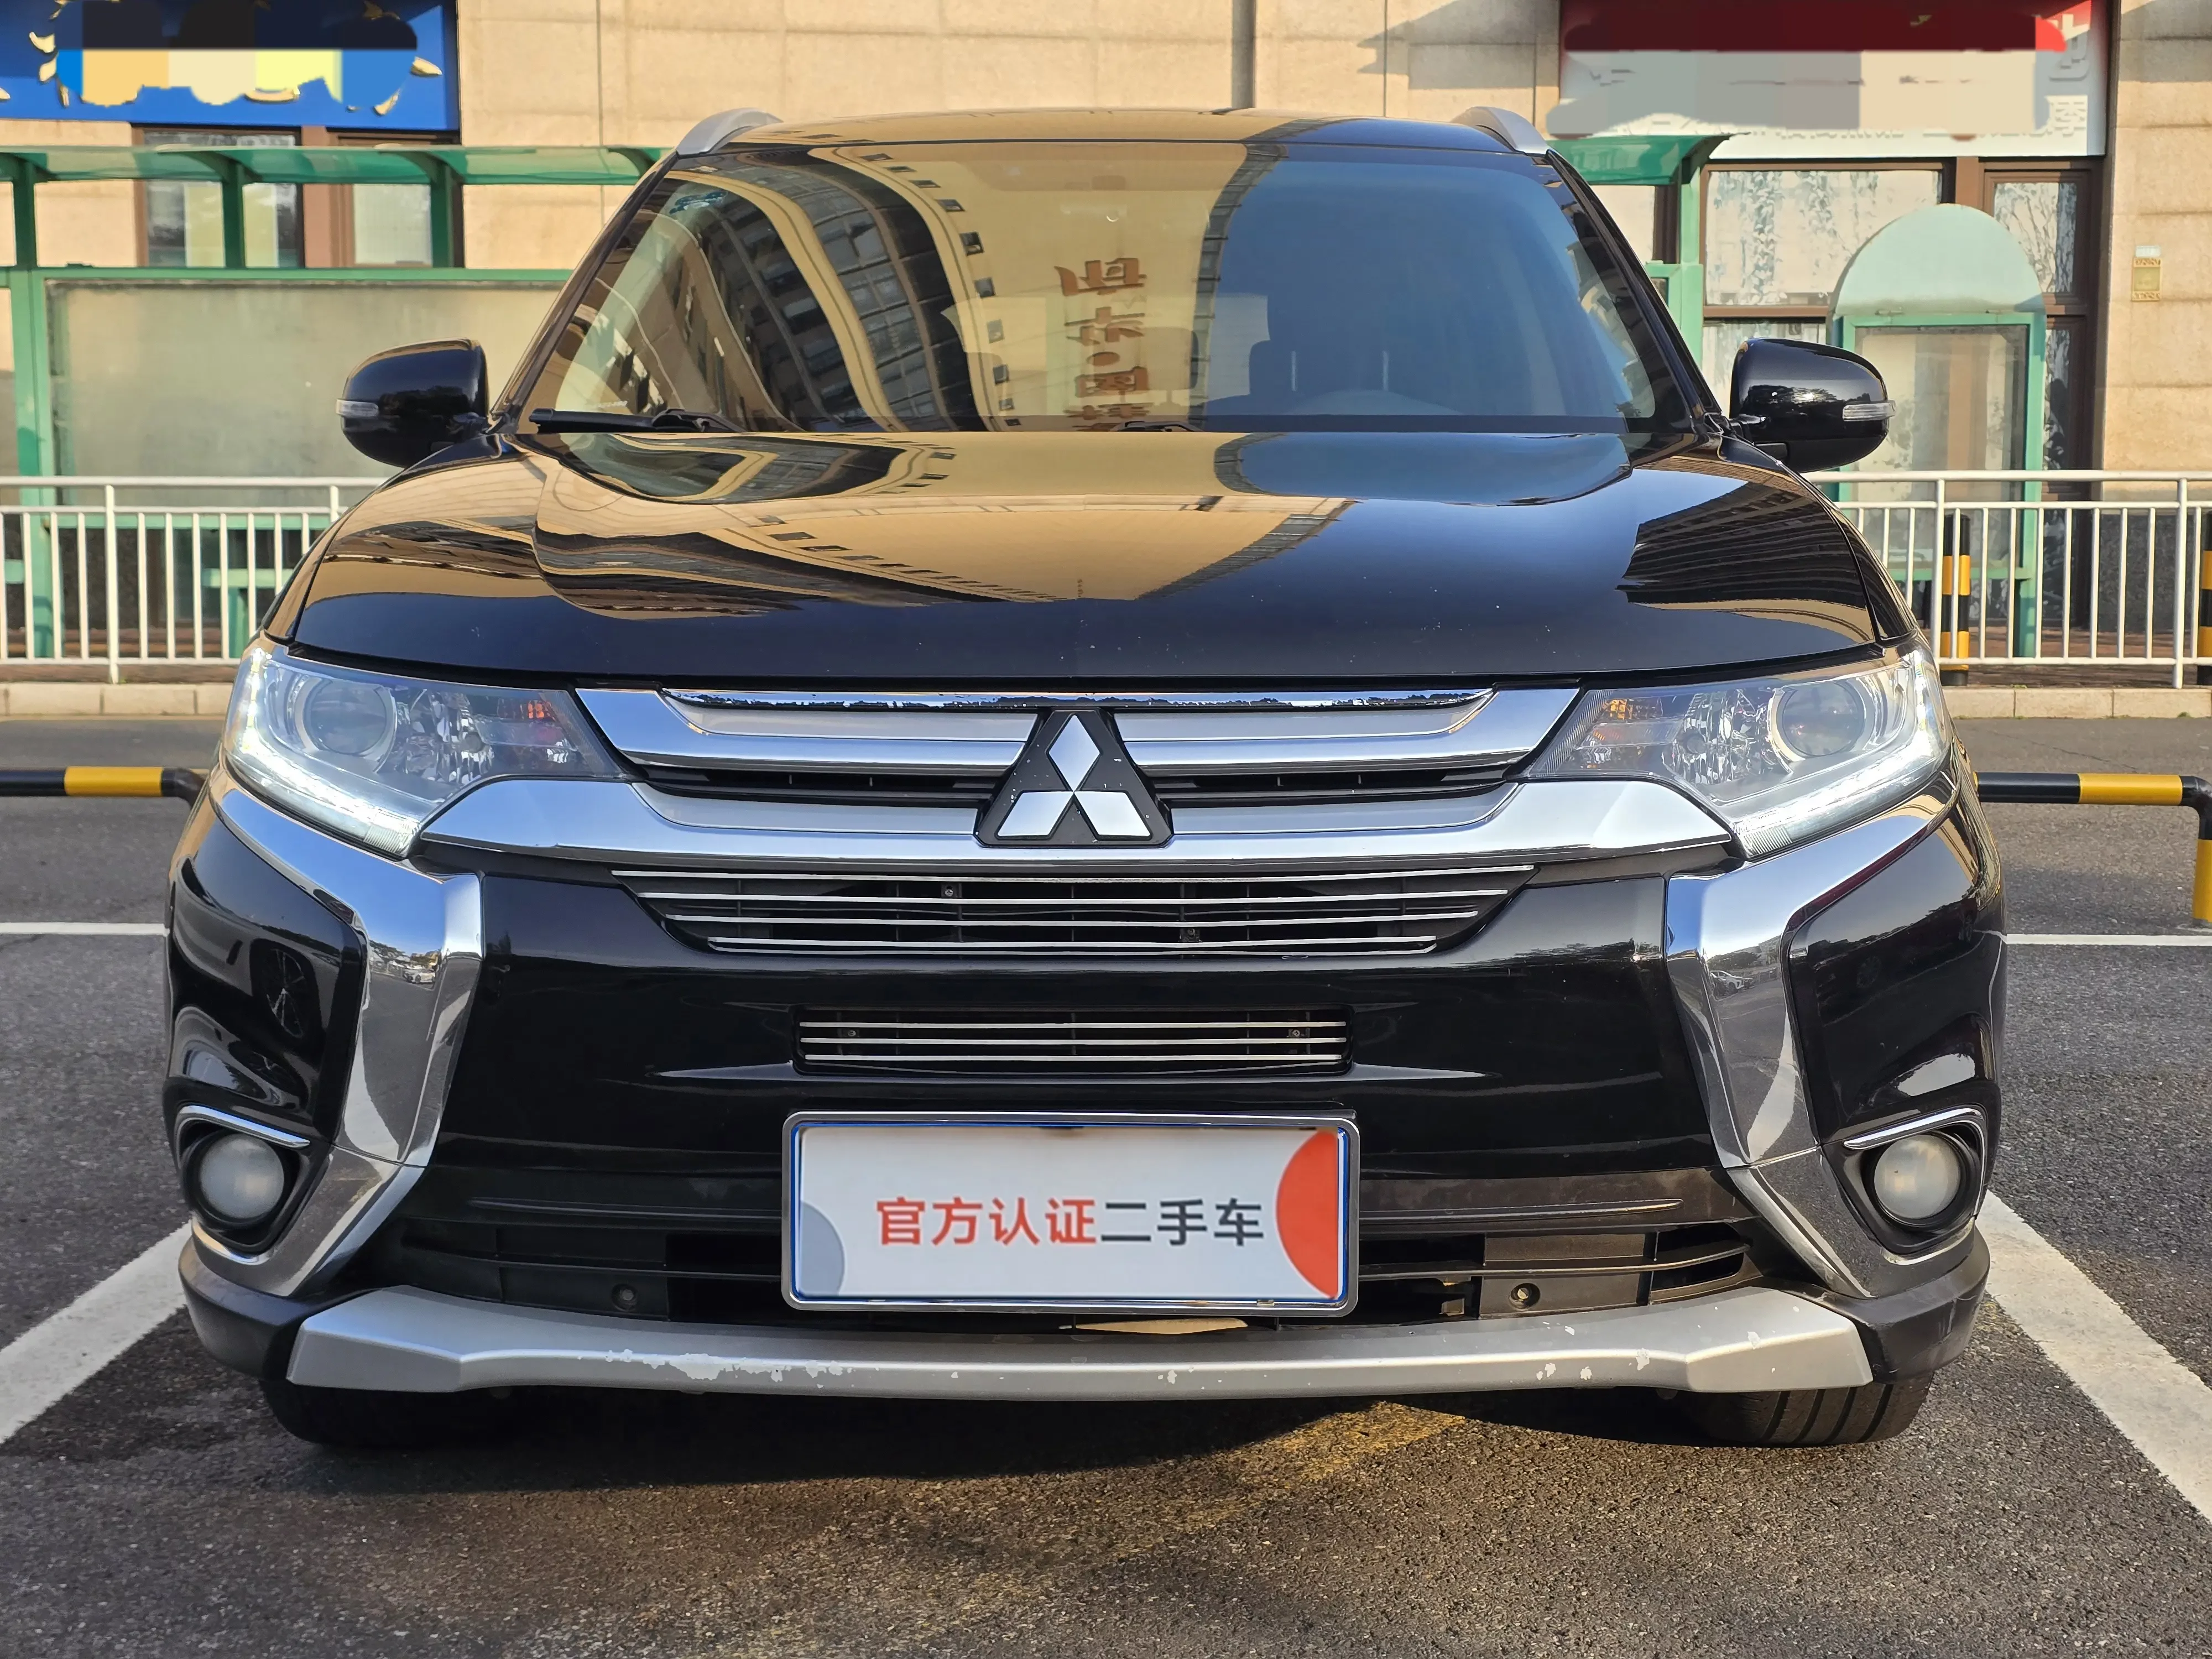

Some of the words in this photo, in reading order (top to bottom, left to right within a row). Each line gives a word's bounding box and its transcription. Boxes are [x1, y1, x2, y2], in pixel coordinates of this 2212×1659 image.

[877, 1196, 1264, 1247] 官方认证二手车
